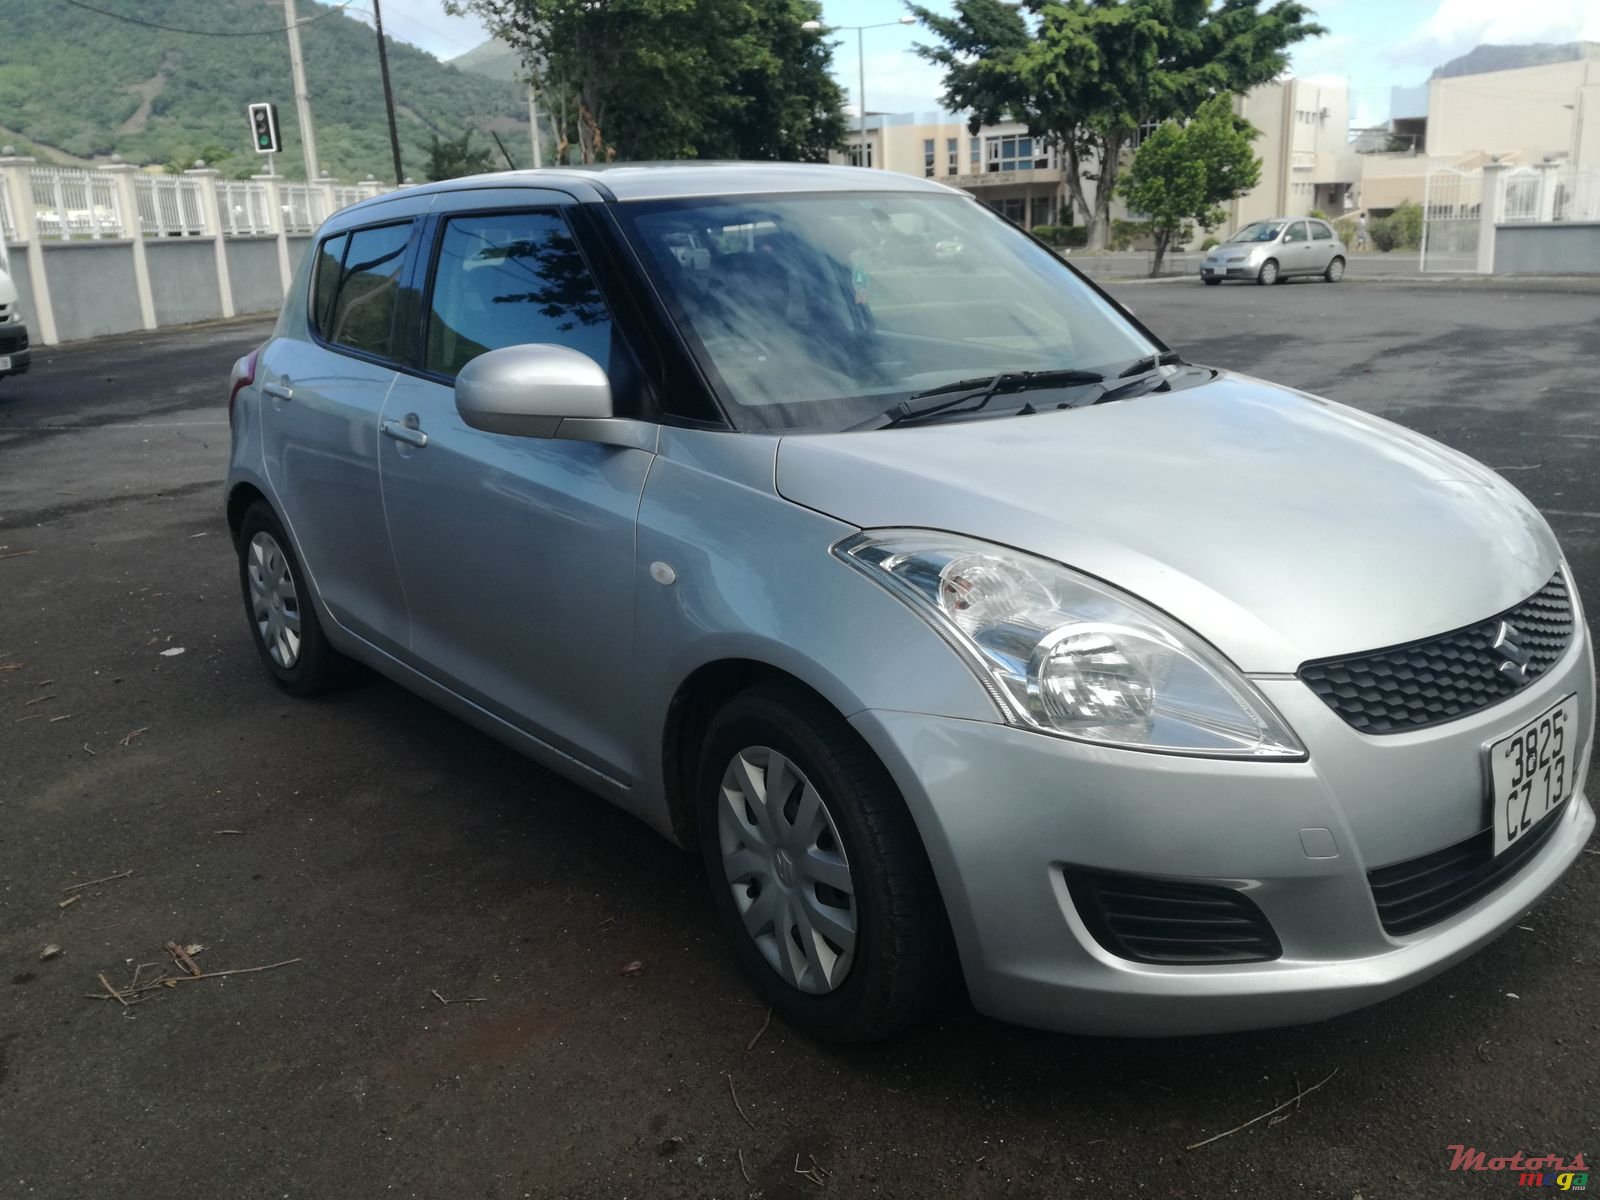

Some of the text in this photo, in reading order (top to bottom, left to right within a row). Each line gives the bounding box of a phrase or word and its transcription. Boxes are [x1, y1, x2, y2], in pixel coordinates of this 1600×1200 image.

[1510, 709, 1563, 788] 3825
[1507, 756, 1564, 841] CZ 13
